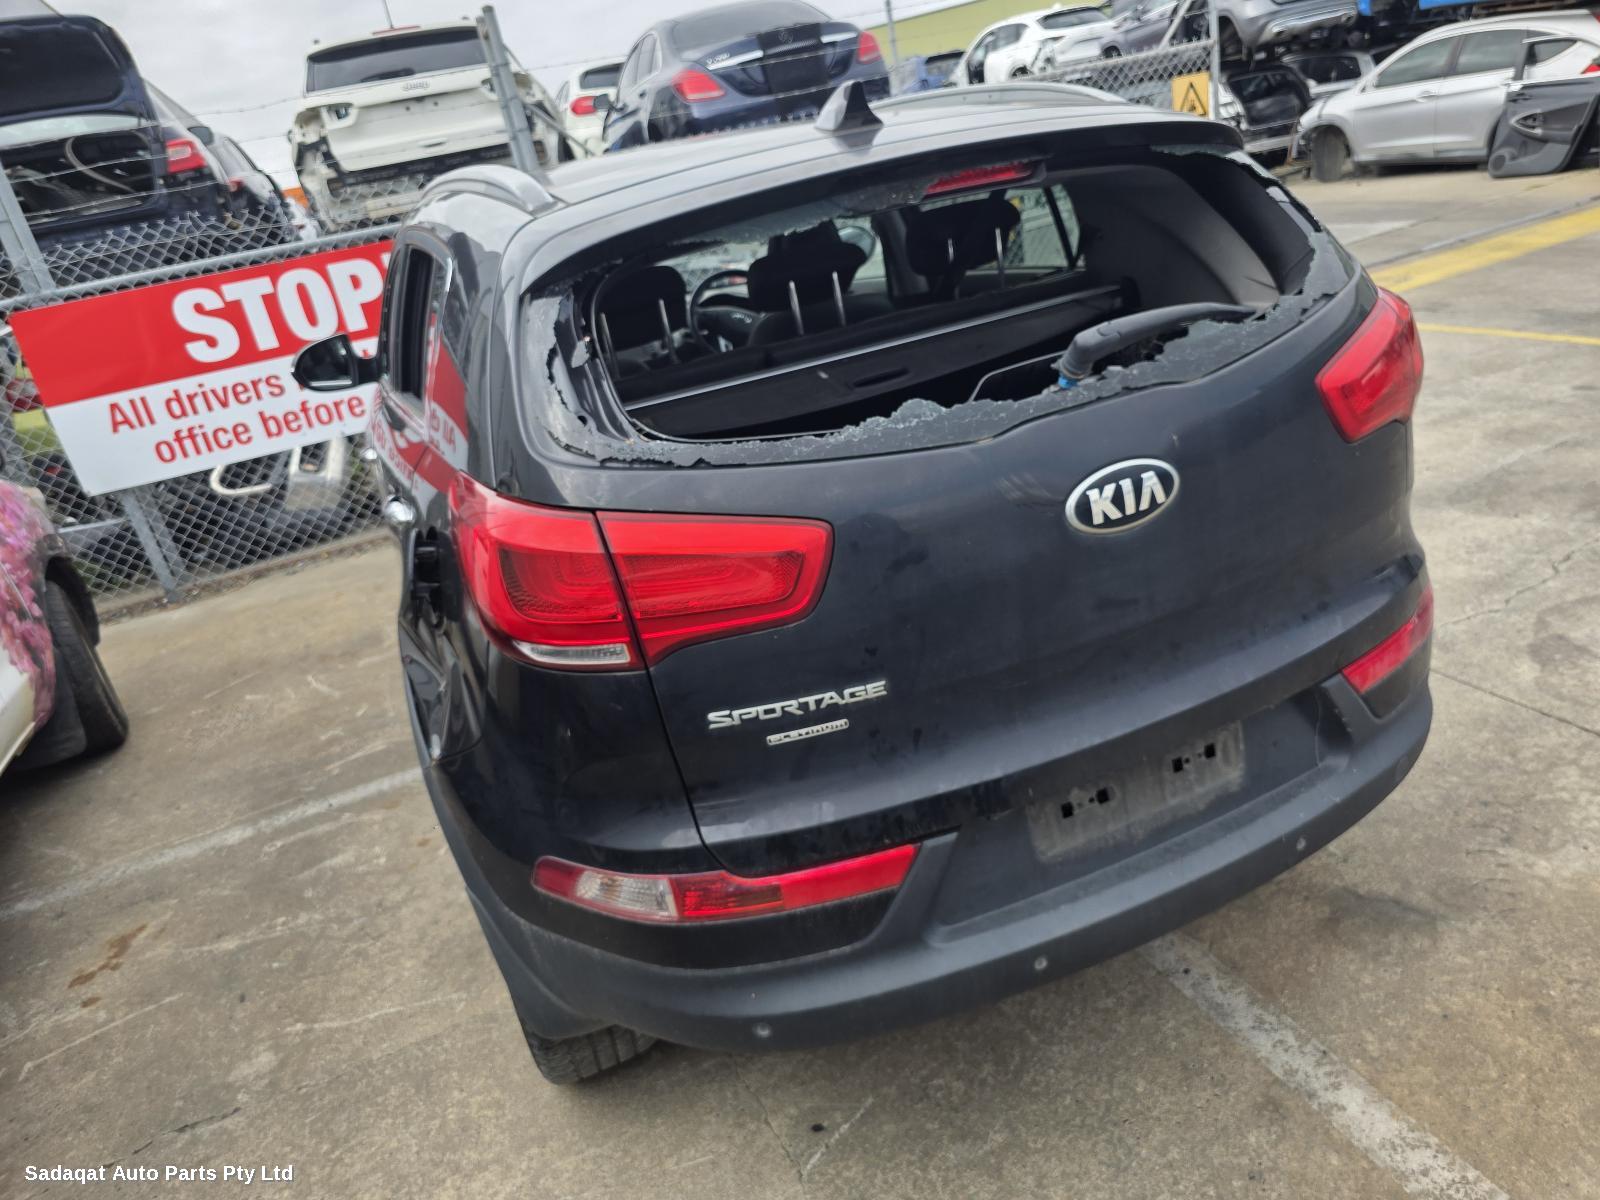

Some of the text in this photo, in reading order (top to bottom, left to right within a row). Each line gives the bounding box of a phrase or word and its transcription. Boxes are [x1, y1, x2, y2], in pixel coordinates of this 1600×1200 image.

[172, 251, 391, 363] STOP
[109, 374, 285, 434] All drivers
[154, 394, 366, 464] office before
[1086, 470, 1166, 525] KIA
[707, 680, 888, 730] SPORTAGE
